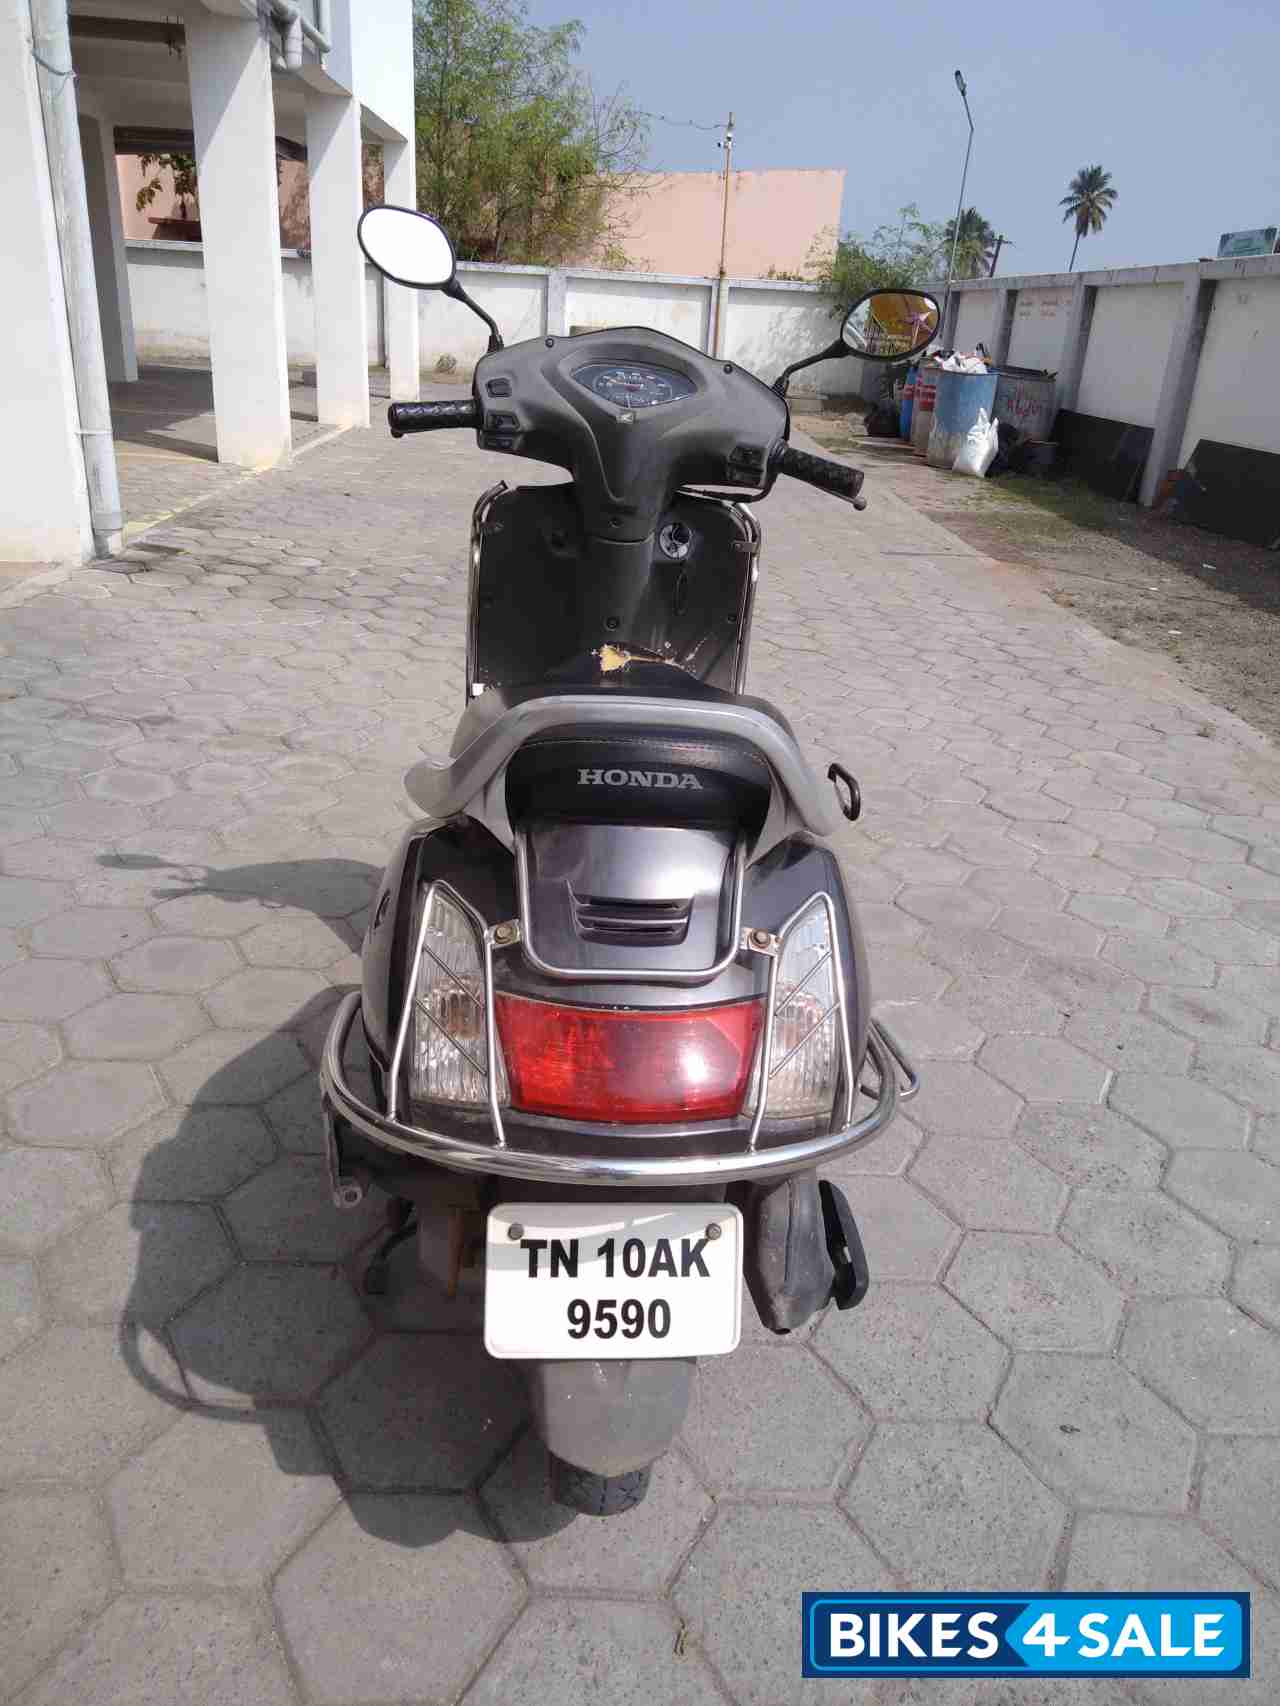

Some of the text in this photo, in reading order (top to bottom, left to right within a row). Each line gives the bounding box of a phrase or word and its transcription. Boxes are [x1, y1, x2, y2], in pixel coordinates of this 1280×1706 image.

[577, 769, 703, 790] HONDA
[520, 1237, 711, 1279] TN 10AK
[567, 1298, 672, 1339] 9590
